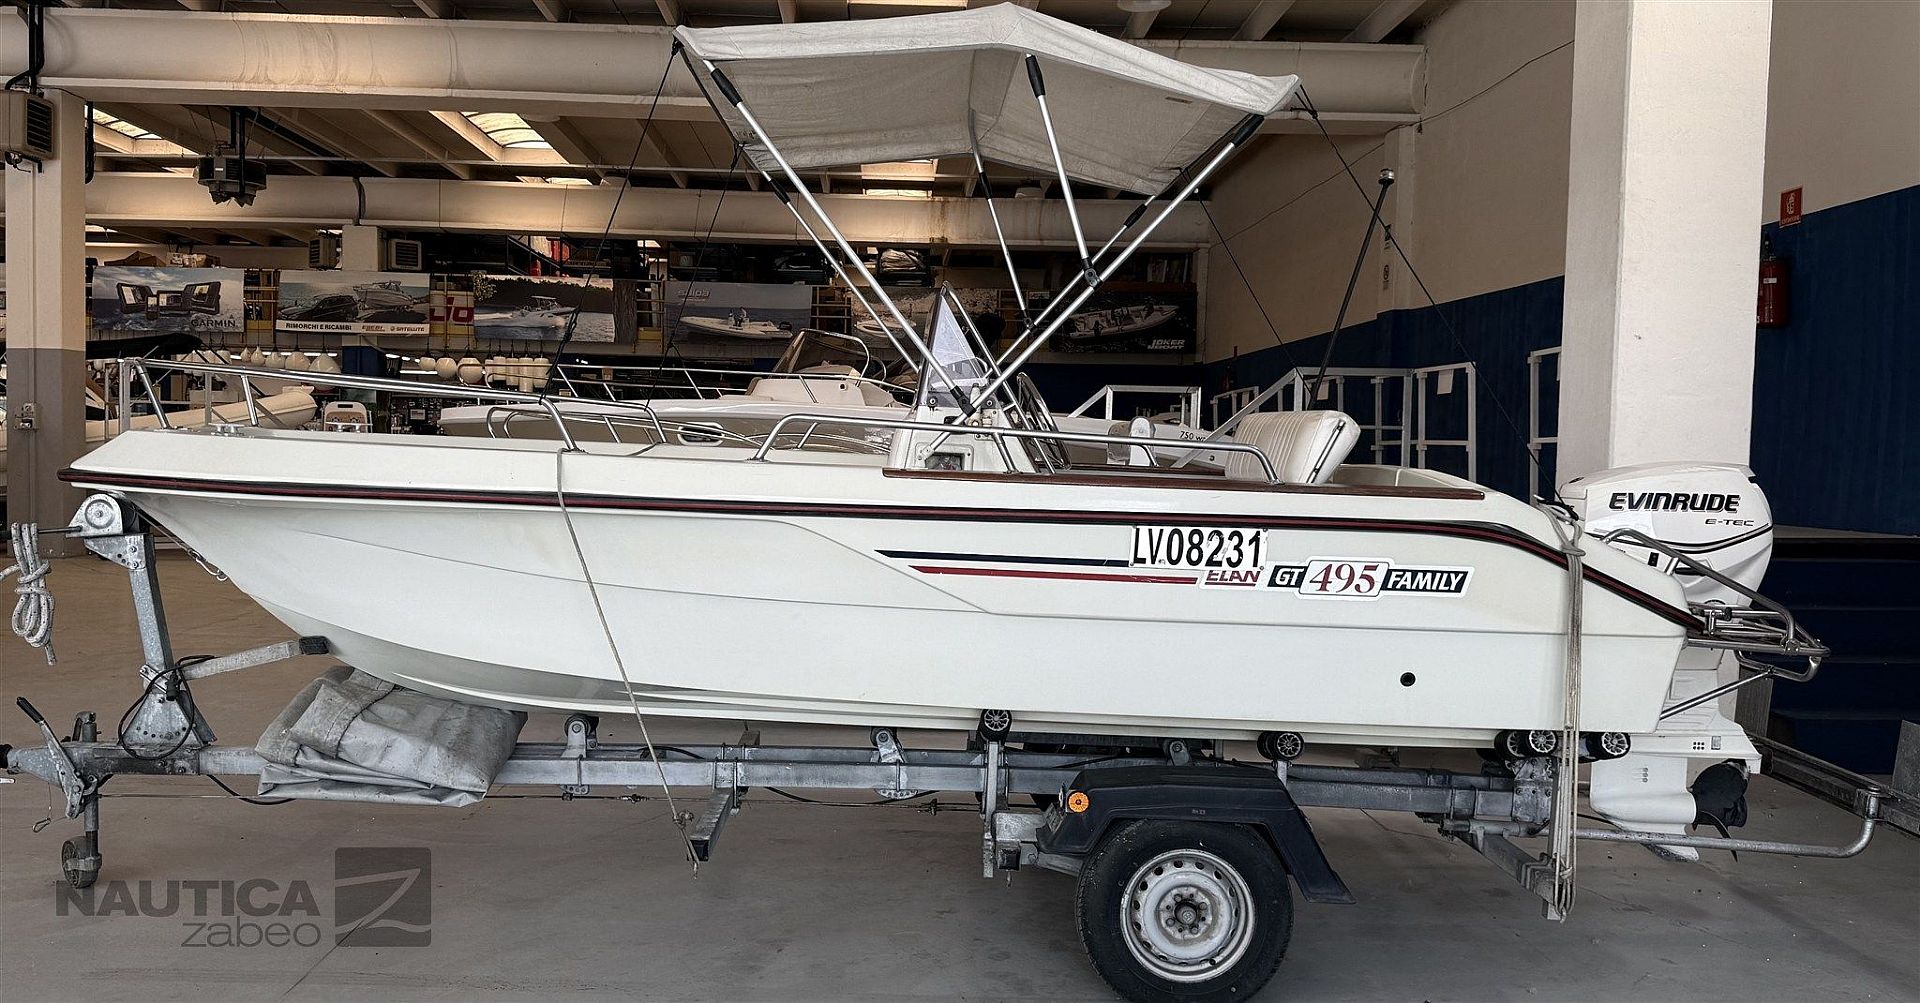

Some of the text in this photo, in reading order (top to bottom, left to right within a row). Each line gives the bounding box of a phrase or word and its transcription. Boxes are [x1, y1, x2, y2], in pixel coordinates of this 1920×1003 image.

[191, 319, 236, 327] GARMIN
[1180, 431, 1194, 440] 750
[1609, 492, 1740, 514] EVINRUDE
[1705, 518, 1755, 527] E-TEC
[1206, 570, 1261, 583] ELAN
[1275, 563, 1464, 594] GT 495 FAMILY
